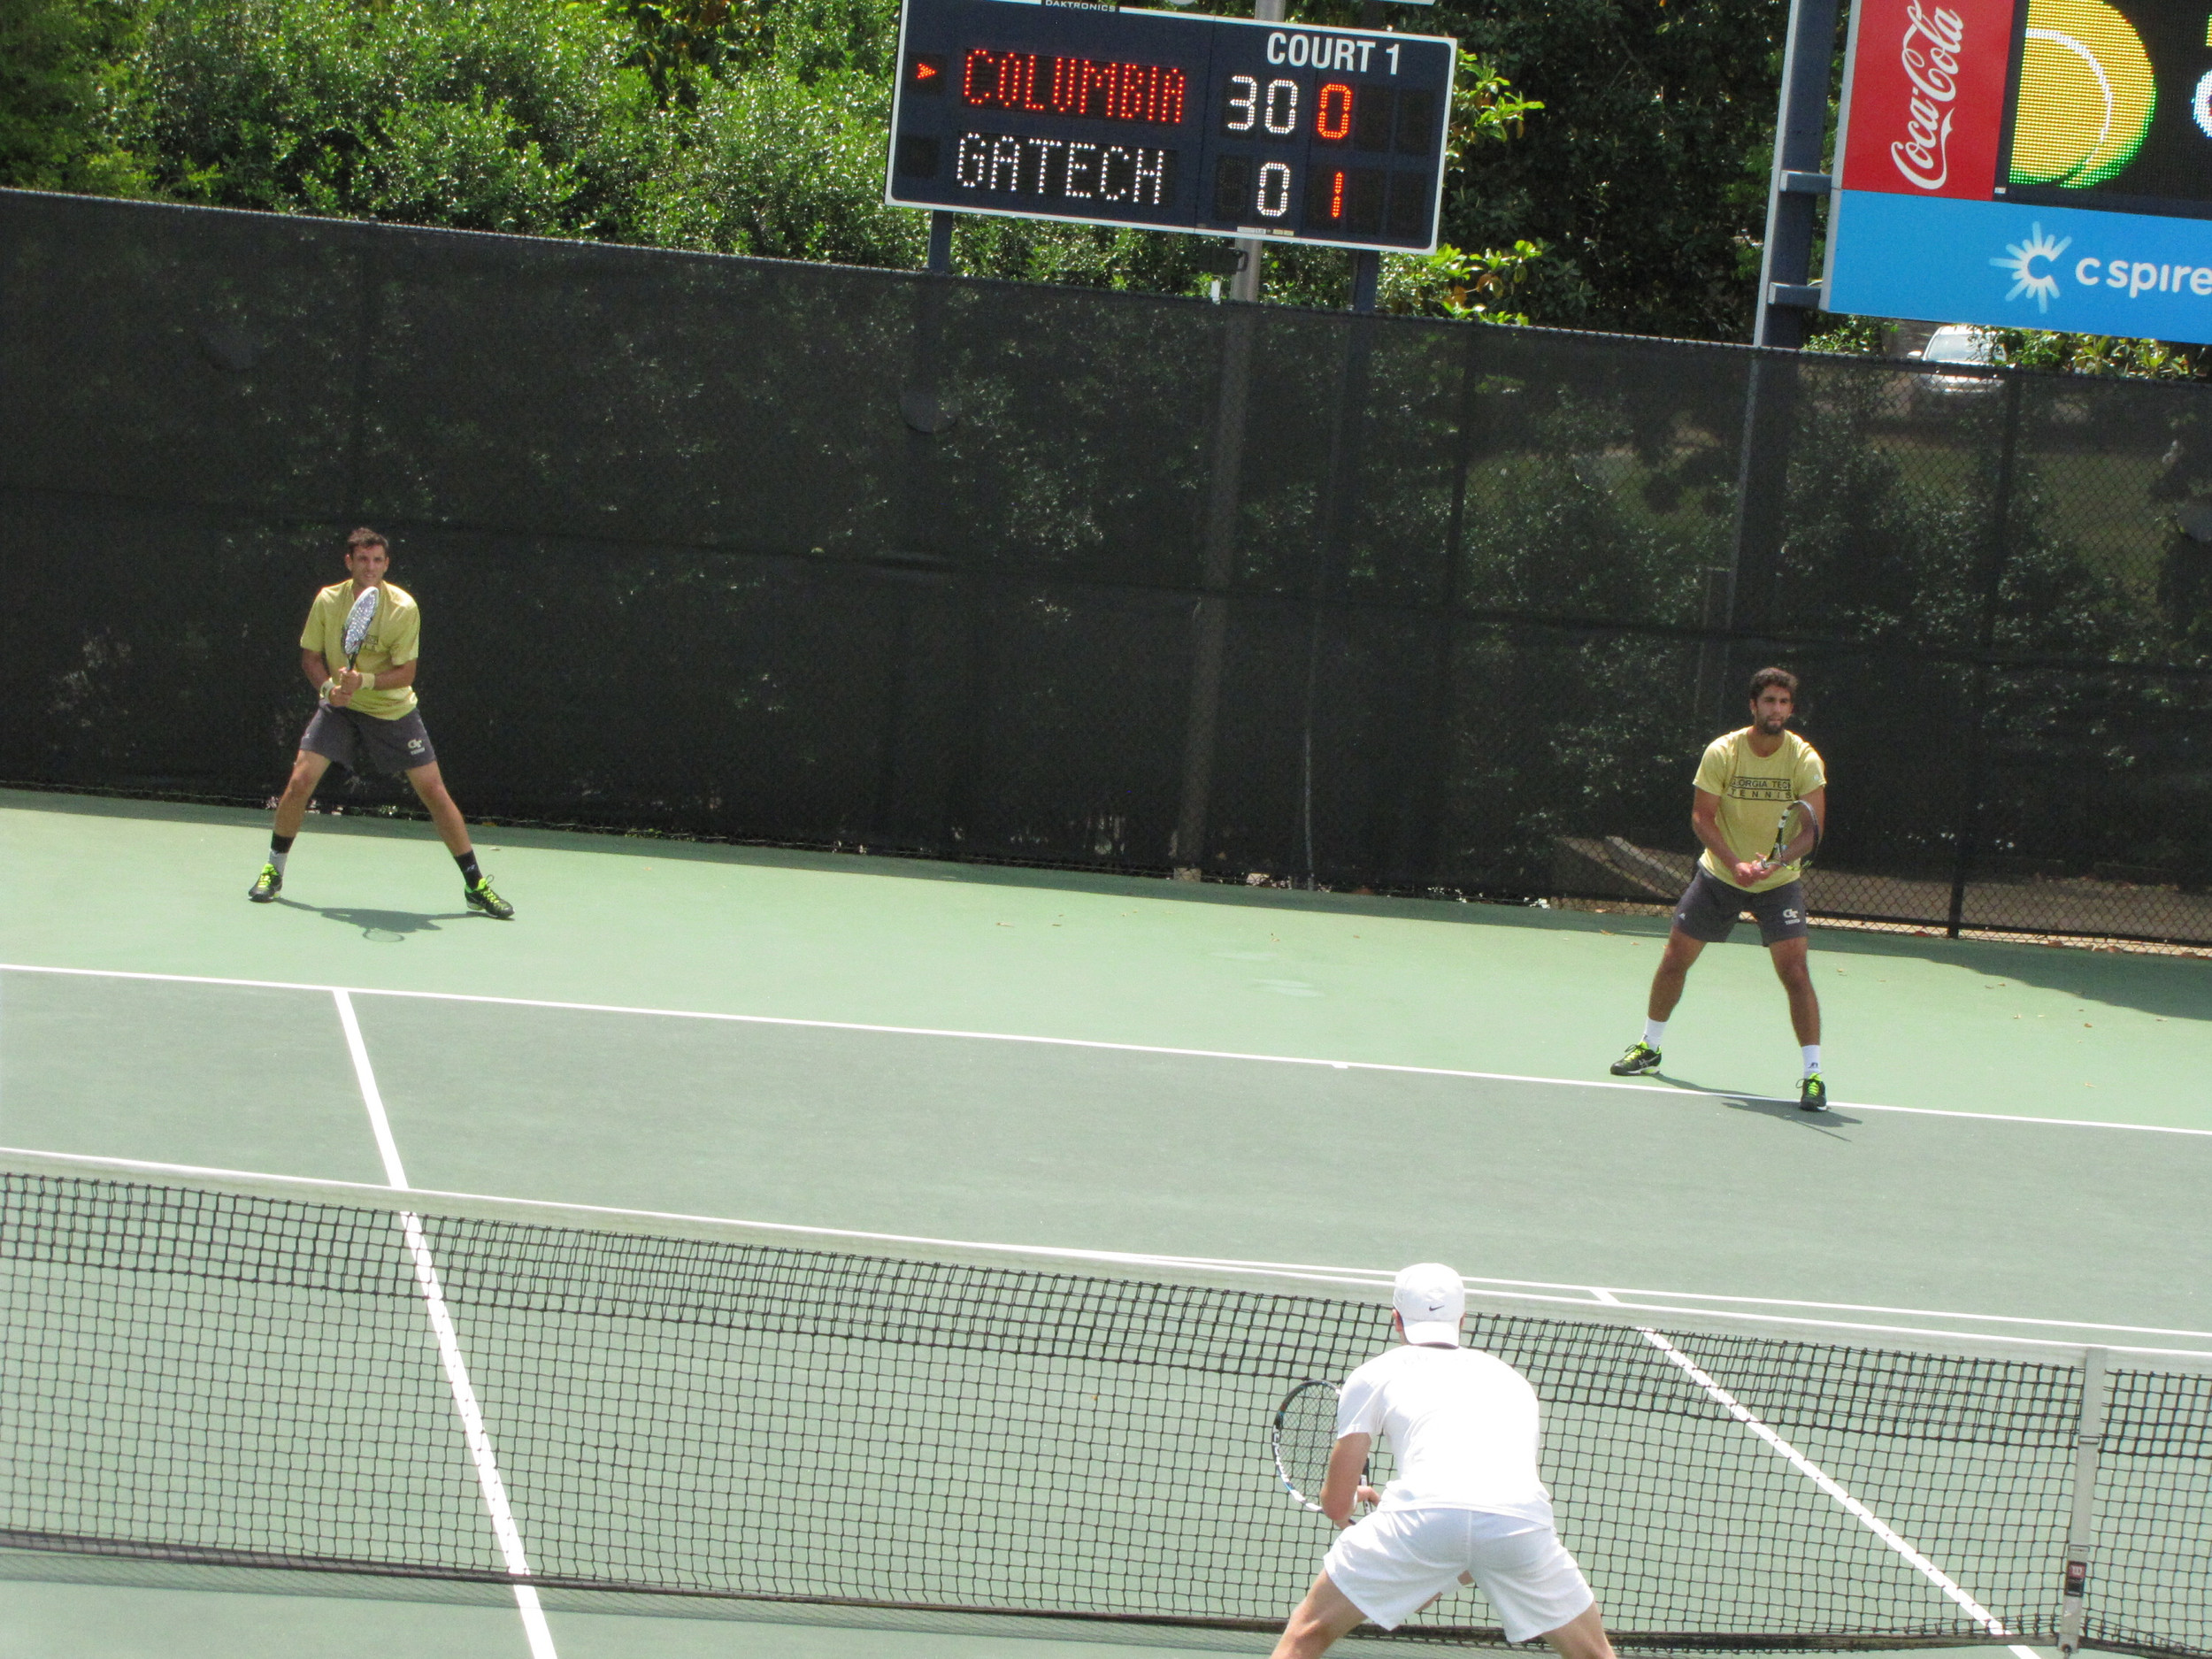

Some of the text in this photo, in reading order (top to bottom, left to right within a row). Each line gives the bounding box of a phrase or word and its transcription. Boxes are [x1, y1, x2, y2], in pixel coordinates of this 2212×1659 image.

[1045, 0, 1116, 12] DAKTRONICS
[1267, 32, 1400, 75] COURT 1
[964, 50, 1352, 140] COLUMBIA 30 0
[1891, 0, 1963, 189] Coca-Cola
[956, 132, 1344, 218] GATECH 0 1
[2106, 259, 2212, 299] spire
[1730, 787, 1792, 799] TENNIS
[1731, 779, 1768, 788] ORGIA
